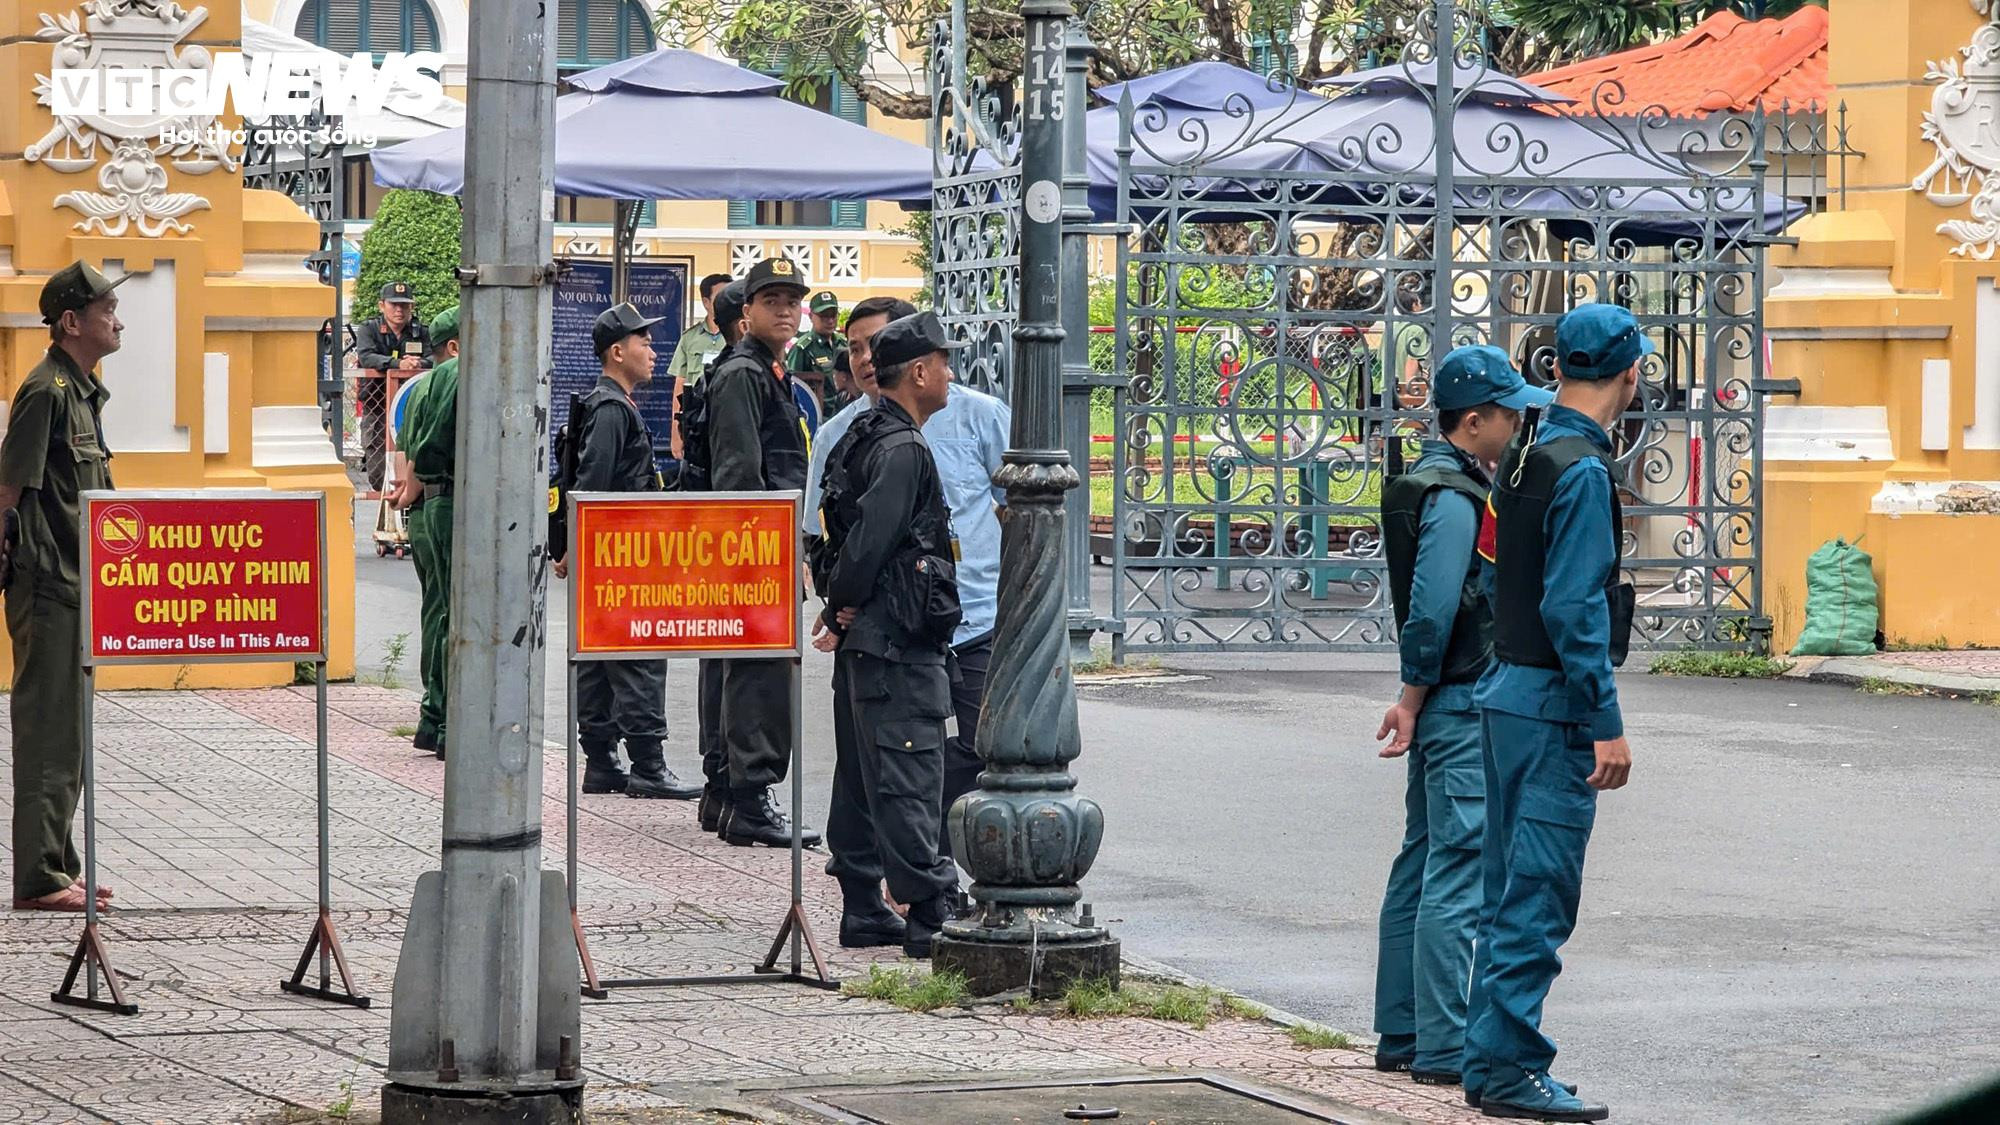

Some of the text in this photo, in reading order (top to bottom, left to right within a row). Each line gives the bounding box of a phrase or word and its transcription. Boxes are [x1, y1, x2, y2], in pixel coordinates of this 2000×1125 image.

[1031, 20, 1065, 52] 13
[1032, 54, 1065, 86] 14
[1029, 89, 1065, 121] 15
[596, 293, 609, 303] RA
[642, 294, 666, 305] QUAN
[149, 520, 263, 553] KHU VỰC
[594, 516, 780, 574] KHU VỰC CẤM
[100, 554, 310, 590] CẤM QUAY PHIM
[135, 593, 276, 627] CHỤP HÌNH
[595, 576, 780, 612] TẬP TRUNG ĐÔNG NGƯỜI
[102, 632, 309, 650] No Camera Use In This Area
[630, 618, 744, 638] NO GATHERING
